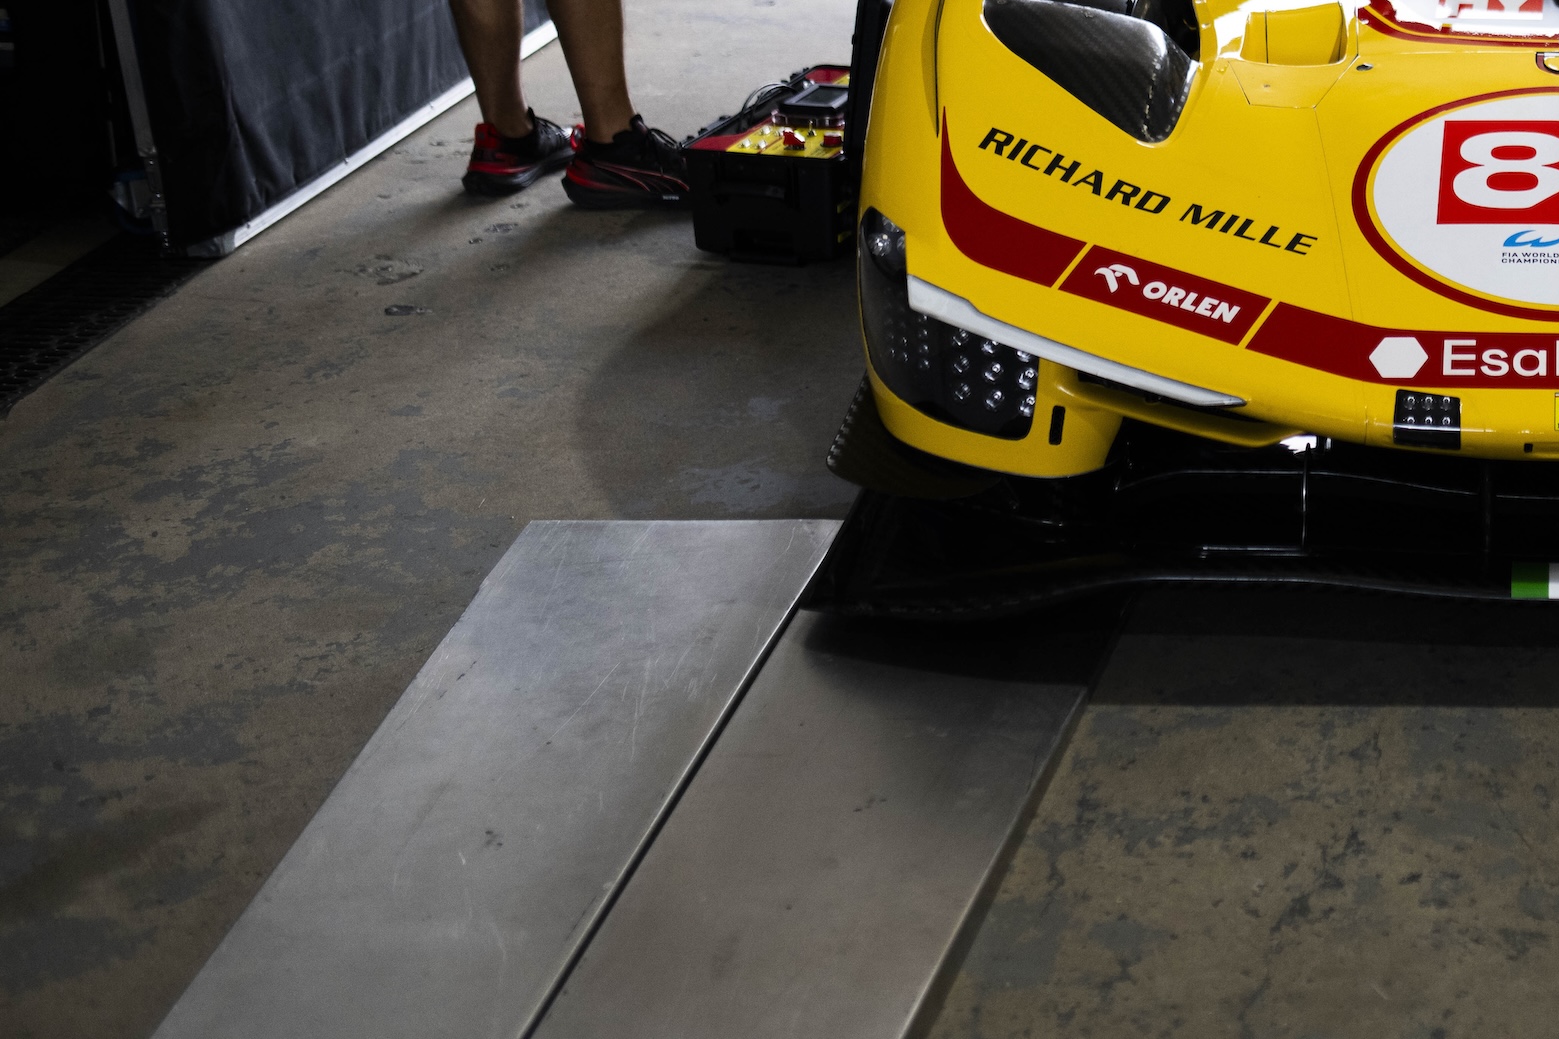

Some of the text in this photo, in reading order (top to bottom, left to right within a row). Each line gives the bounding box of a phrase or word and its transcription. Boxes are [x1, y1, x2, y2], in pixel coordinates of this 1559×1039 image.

[978, 126, 1319, 255] RICHARD MILLE
[1142, 280, 1241, 324] ORLEN
